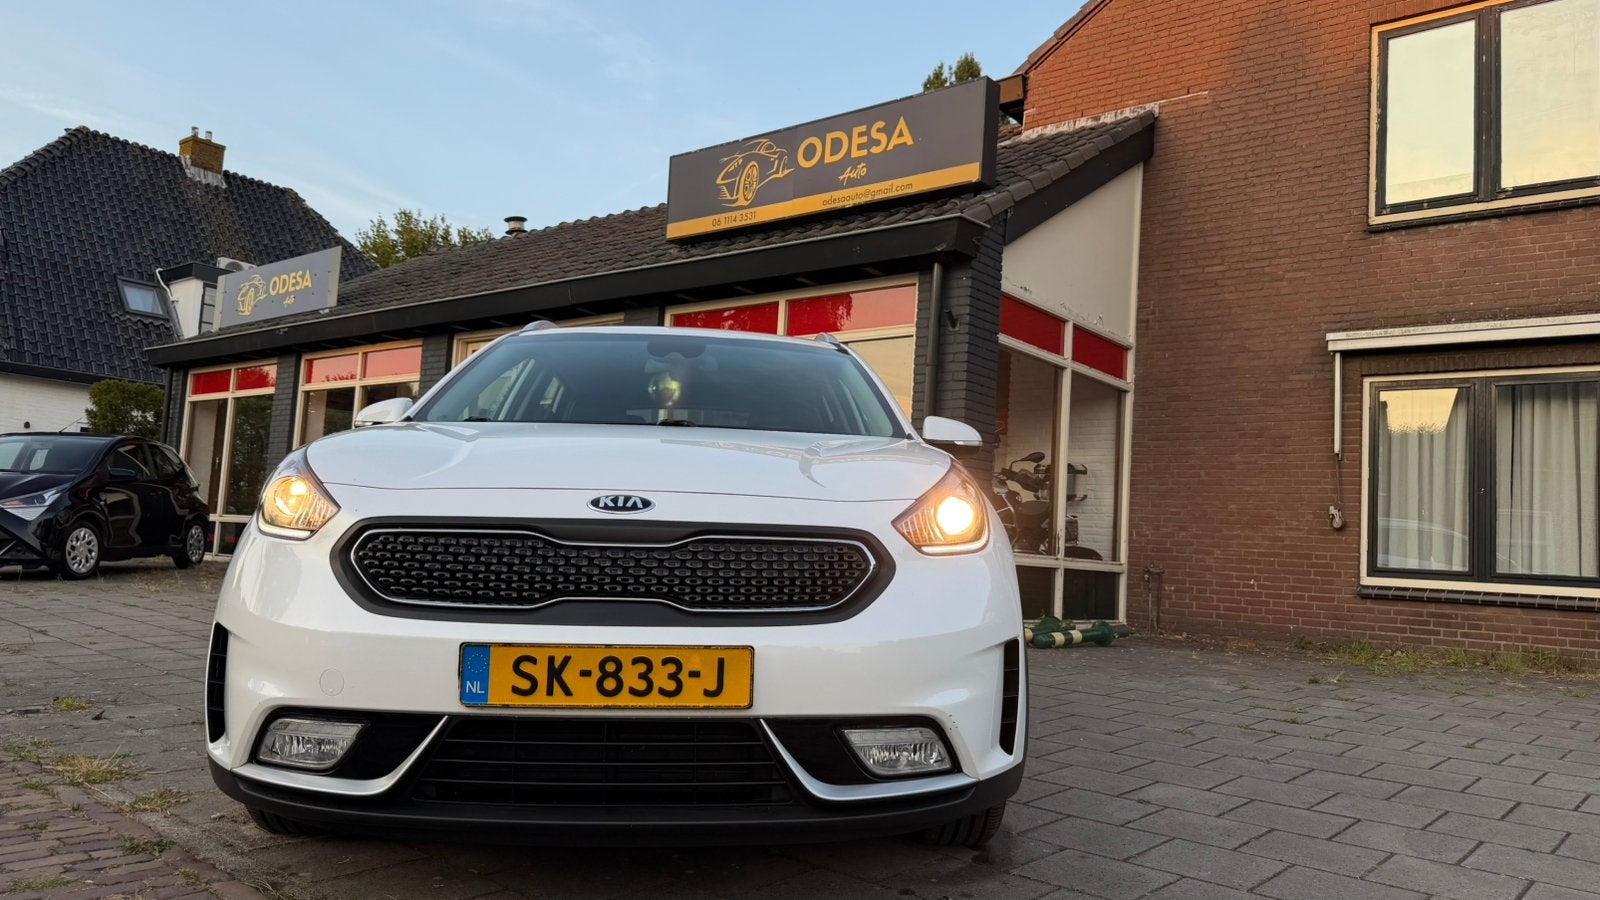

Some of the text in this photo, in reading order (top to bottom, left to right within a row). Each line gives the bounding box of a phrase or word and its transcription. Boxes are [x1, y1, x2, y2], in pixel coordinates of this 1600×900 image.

[797, 116, 914, 168] ODESA
[838, 162, 867, 186] Auto
[822, 183, 912, 206] odesaauto@gmail.com
[712, 211, 756, 227] 06 1114 3531
[269, 269, 312, 296] ODESA
[598, 495, 643, 508] KIA
[465, 681, 485, 694] NL
[511, 655, 725, 698] SK-833-J
